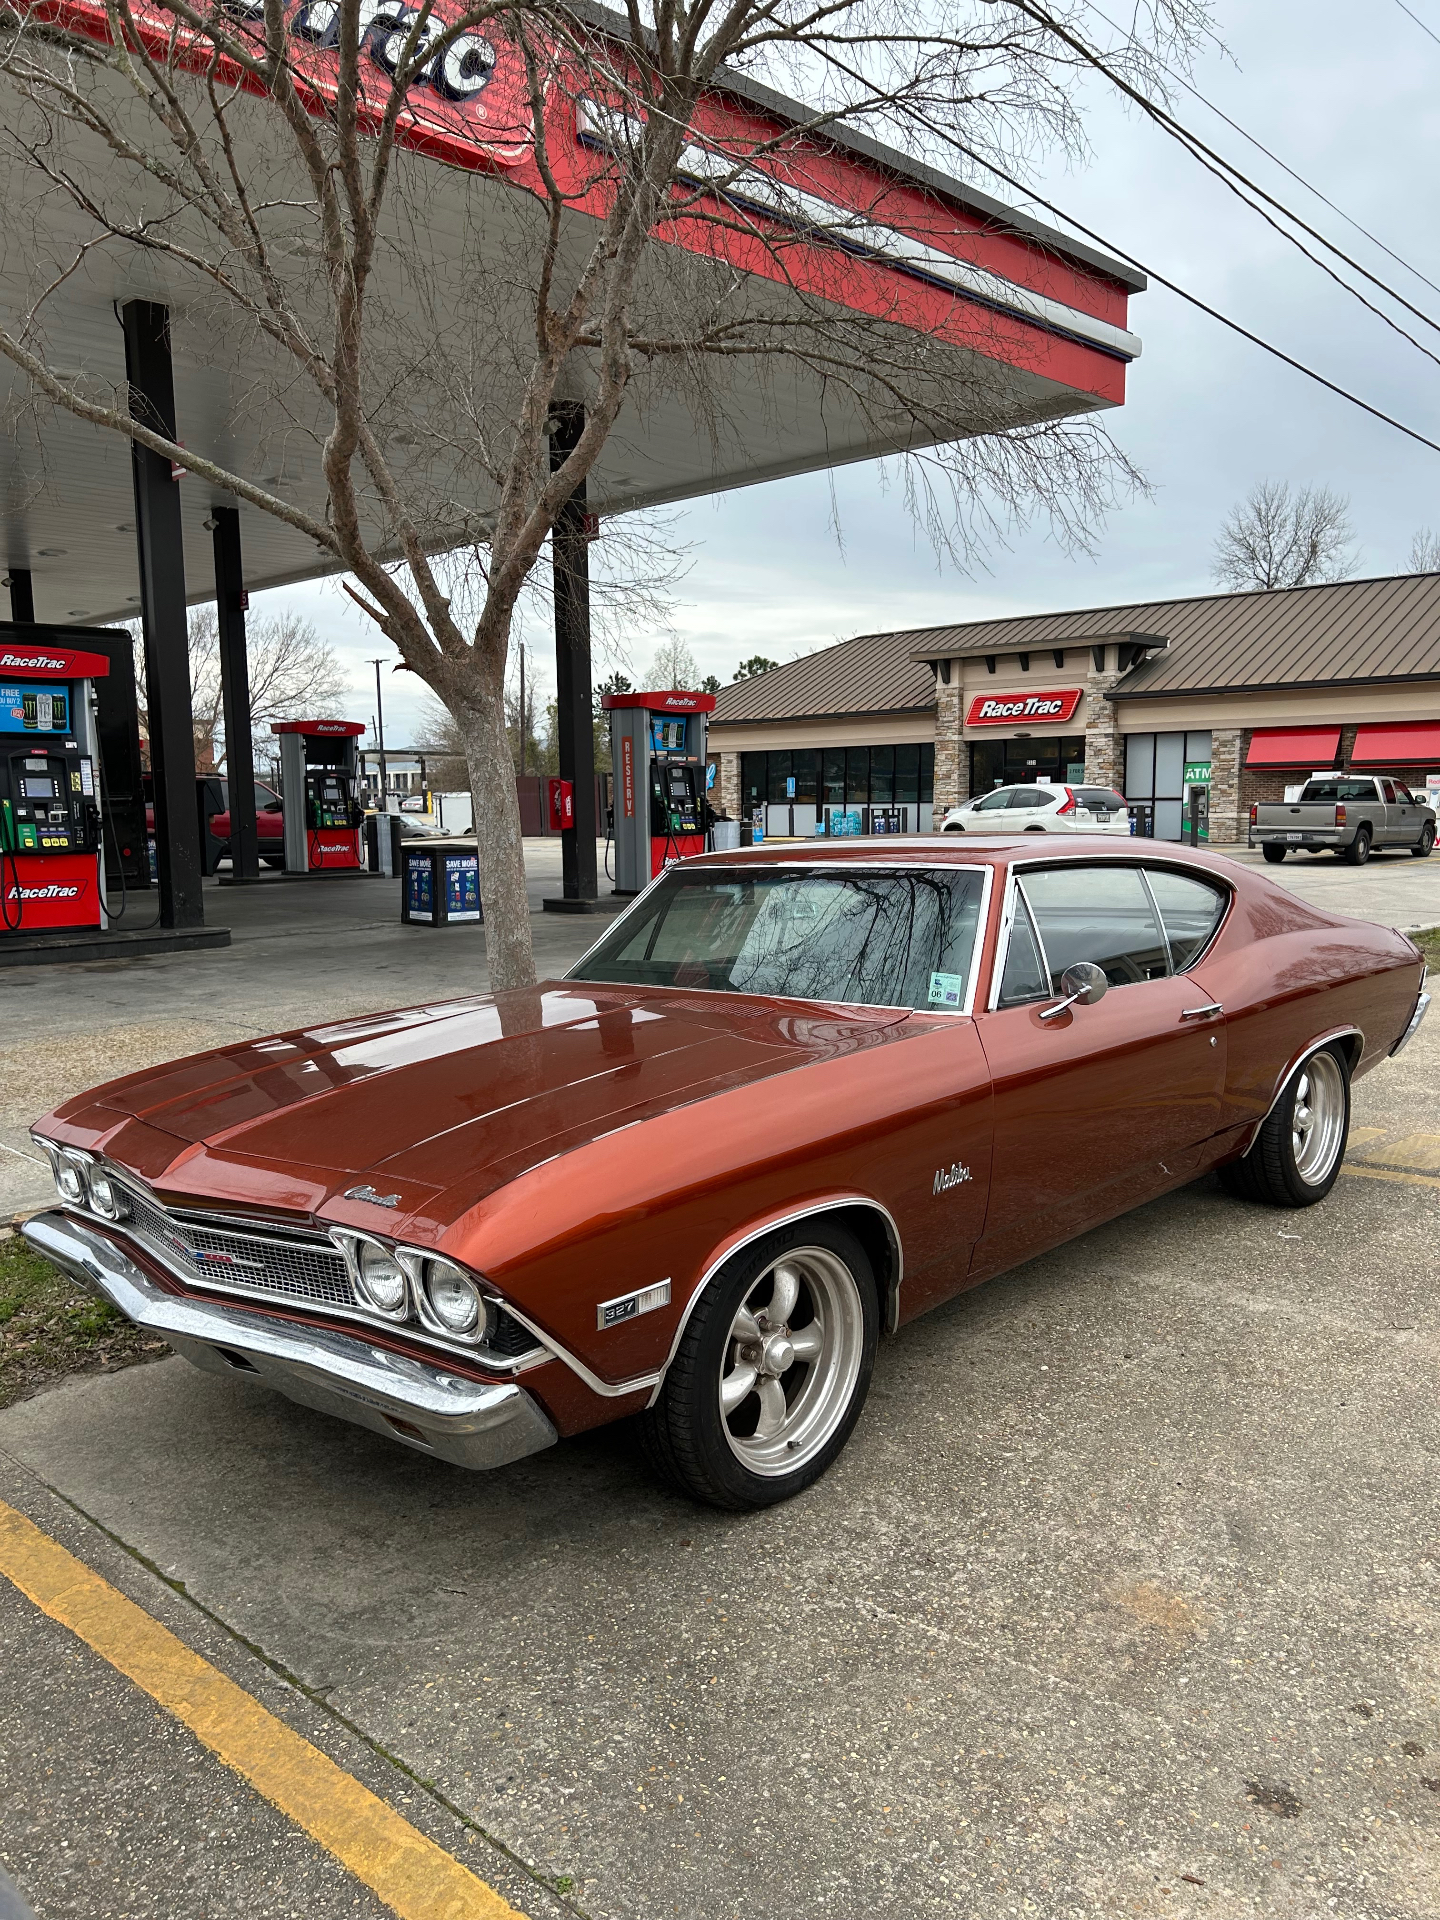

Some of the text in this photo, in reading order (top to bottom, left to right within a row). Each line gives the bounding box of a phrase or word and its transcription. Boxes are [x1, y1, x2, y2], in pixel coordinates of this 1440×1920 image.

[0, 654, 66, 669] RaceTrac
[1, 689, 20, 697] FREE
[665, 697, 697, 706] RaceTrac
[979, 698, 1062, 718] RaceTrac
[1186, 768, 1211, 780] ATM
[462, 860, 478, 868] MORE
[7, 885, 78, 899] RaceTrac
[931, 991, 958, 1002] 06 23
[605, 1300, 634, 1320] 327
